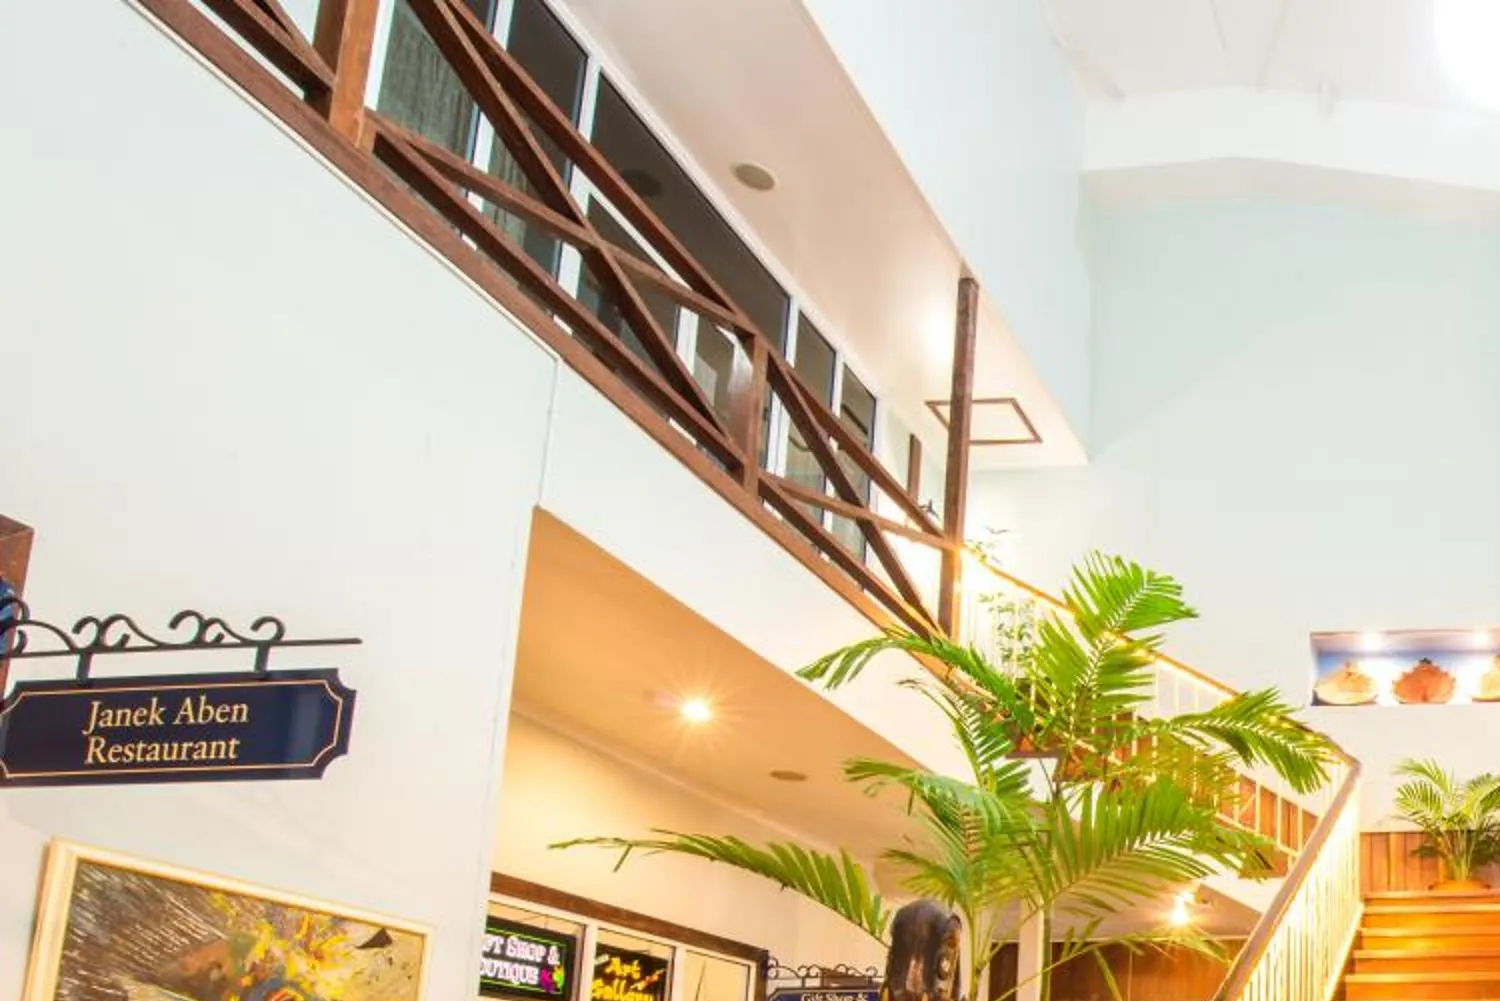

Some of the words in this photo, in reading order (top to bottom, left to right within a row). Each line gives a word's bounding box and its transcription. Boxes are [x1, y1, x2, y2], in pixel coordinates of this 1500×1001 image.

[82, 696, 166, 734] Janek
[173, 693, 249, 725] Aben
[84, 737, 241, 764] Restaurant
[604, 956, 641, 980] Art
